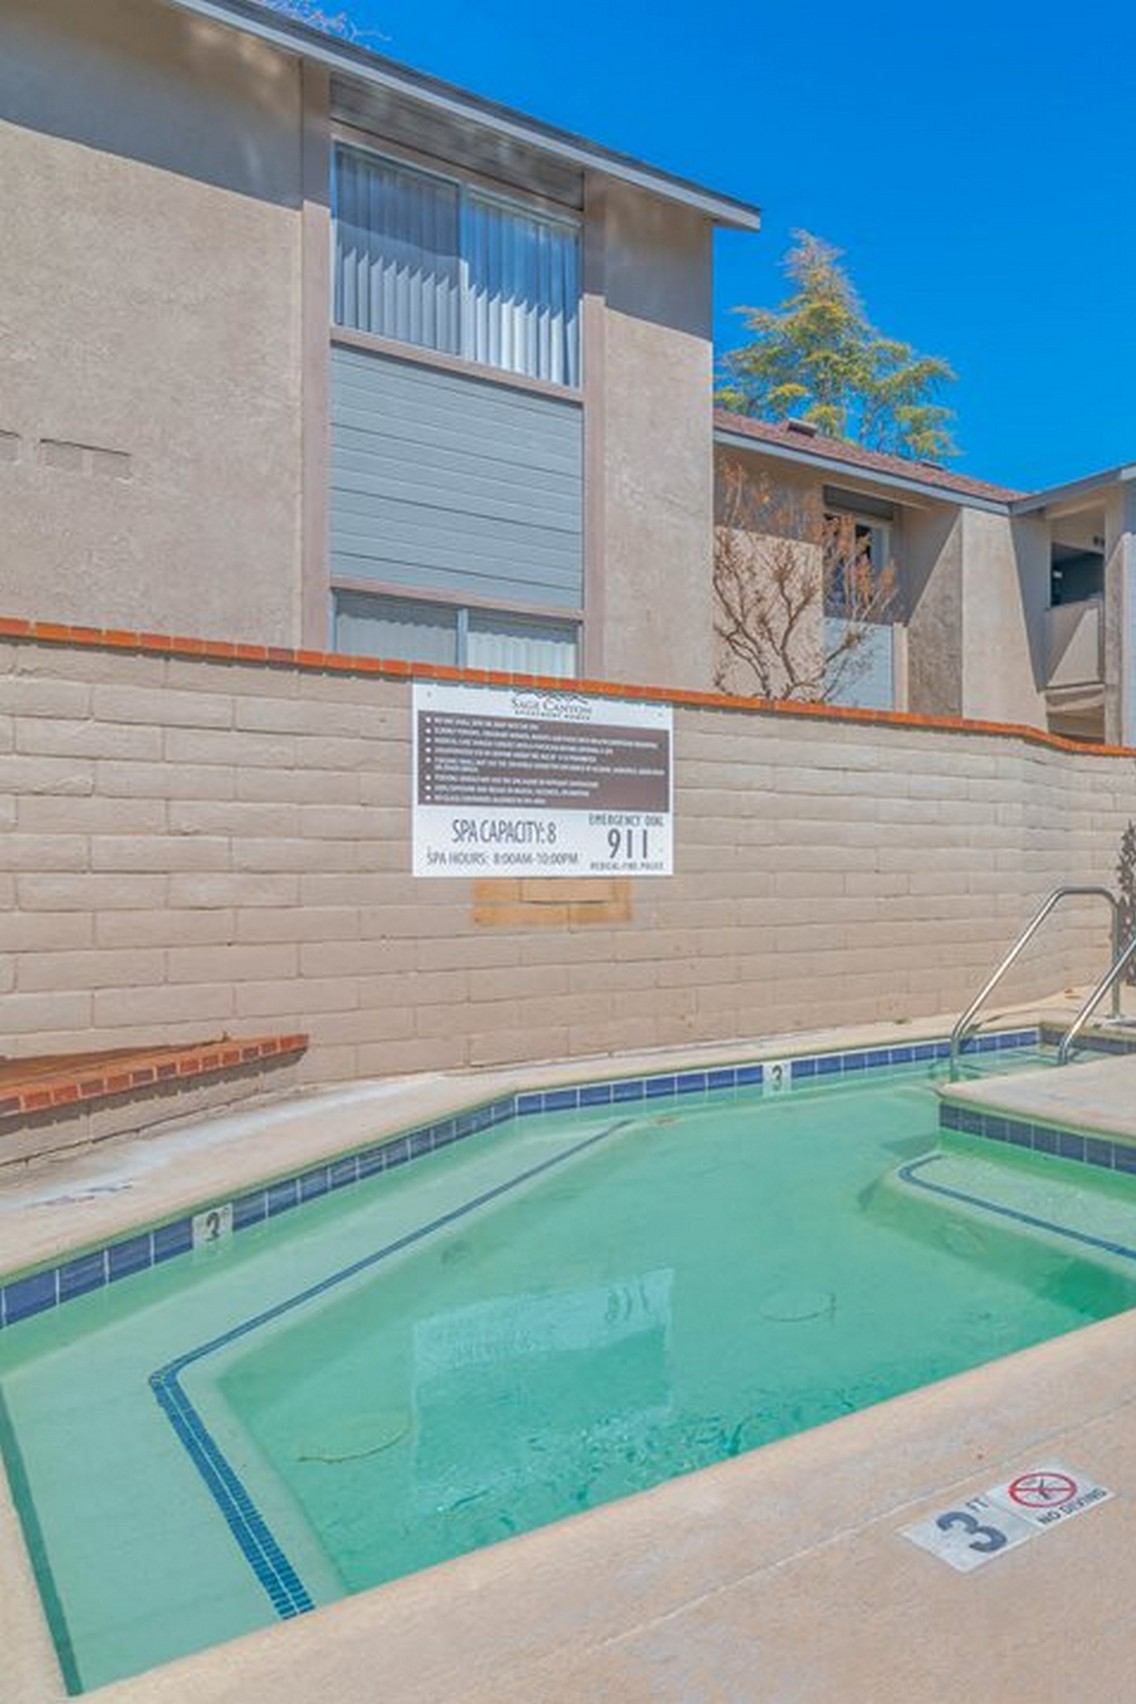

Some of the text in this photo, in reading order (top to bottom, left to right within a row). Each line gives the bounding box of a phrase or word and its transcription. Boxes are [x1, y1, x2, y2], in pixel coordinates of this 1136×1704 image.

[452, 819, 557, 844] SPA CAPACITY: 8
[588, 812, 641, 827] EMERGENCY
[607, 828, 648, 859] 911
[426, 851, 447, 866] SPA
[449, 851, 488, 866] HOURS:
[772, 1064, 783, 1091] 3
[206, 1211, 220, 1242] 3
[1036, 1487, 1108, 1526] NO DIVING
[936, 1511, 1008, 1553] 3
